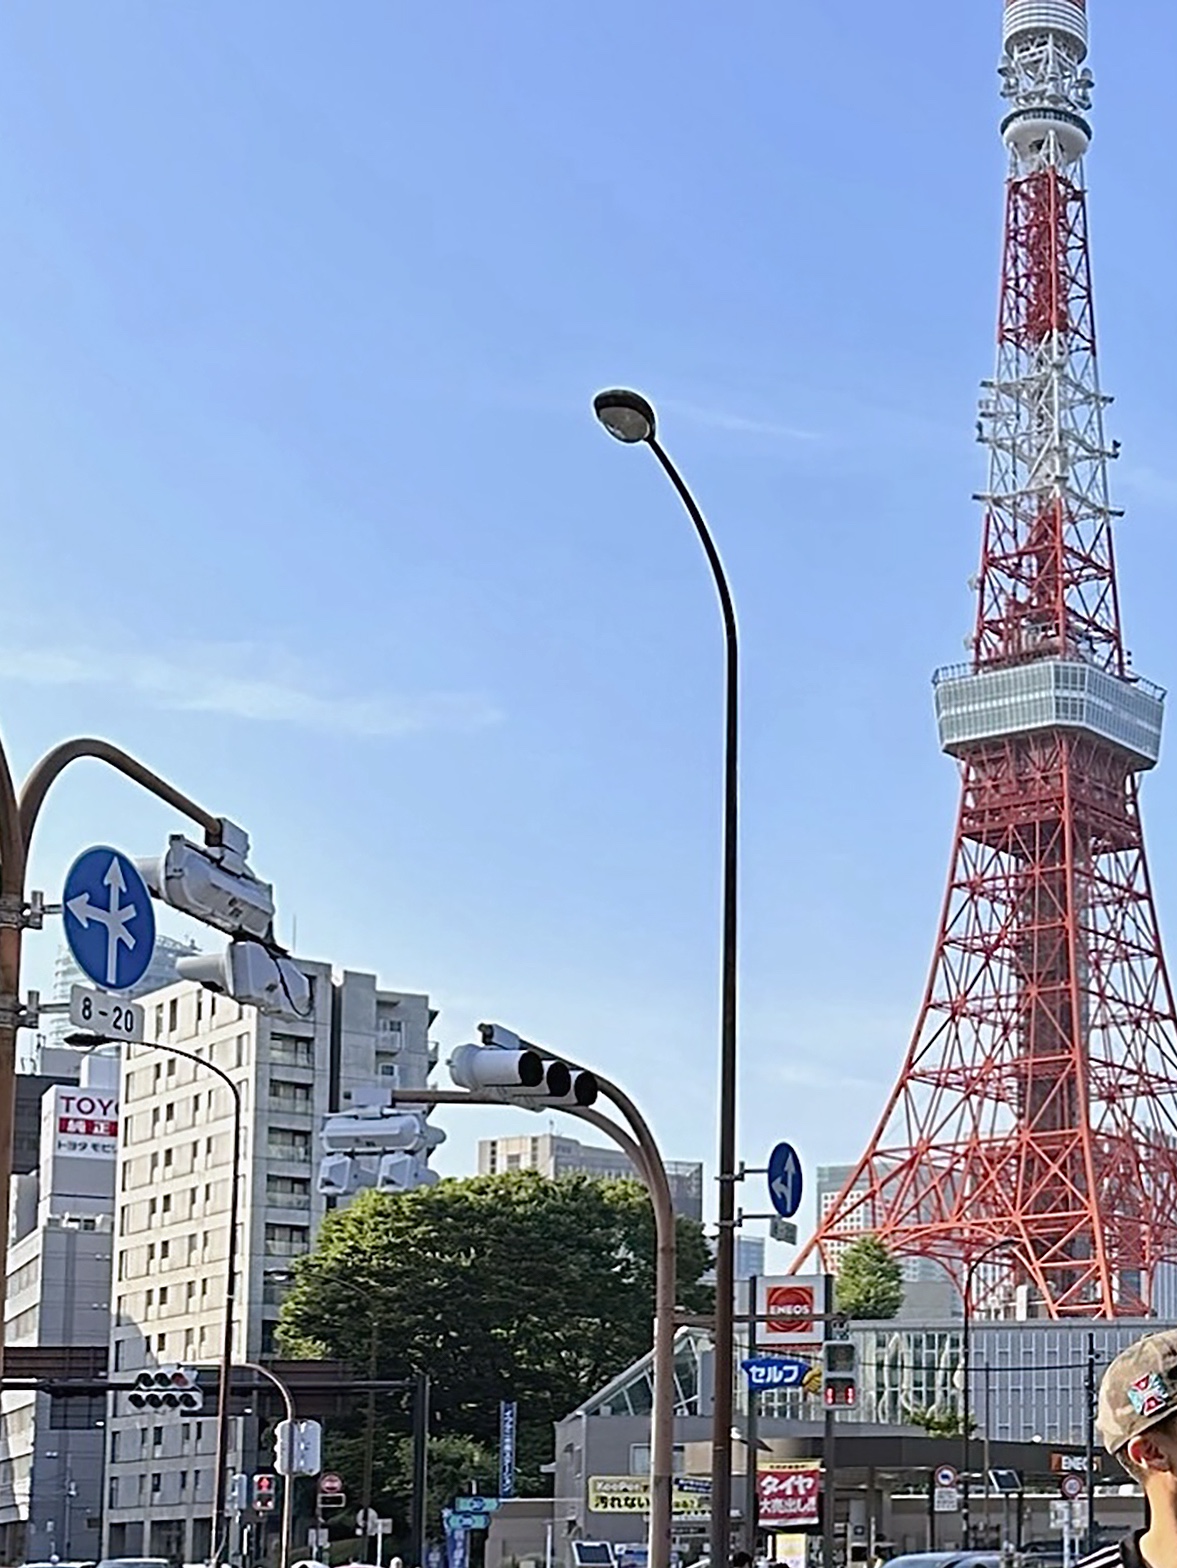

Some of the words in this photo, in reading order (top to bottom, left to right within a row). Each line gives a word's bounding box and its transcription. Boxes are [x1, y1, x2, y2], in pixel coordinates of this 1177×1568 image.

[81, 996, 135, 1034] 8-20
[60, 1095, 118, 1116] TOY
[769, 1304, 810, 1315] ENEOS
[748, 1365, 799, 1384] セルフ
[760, 1474, 815, 1496] タイヤ
